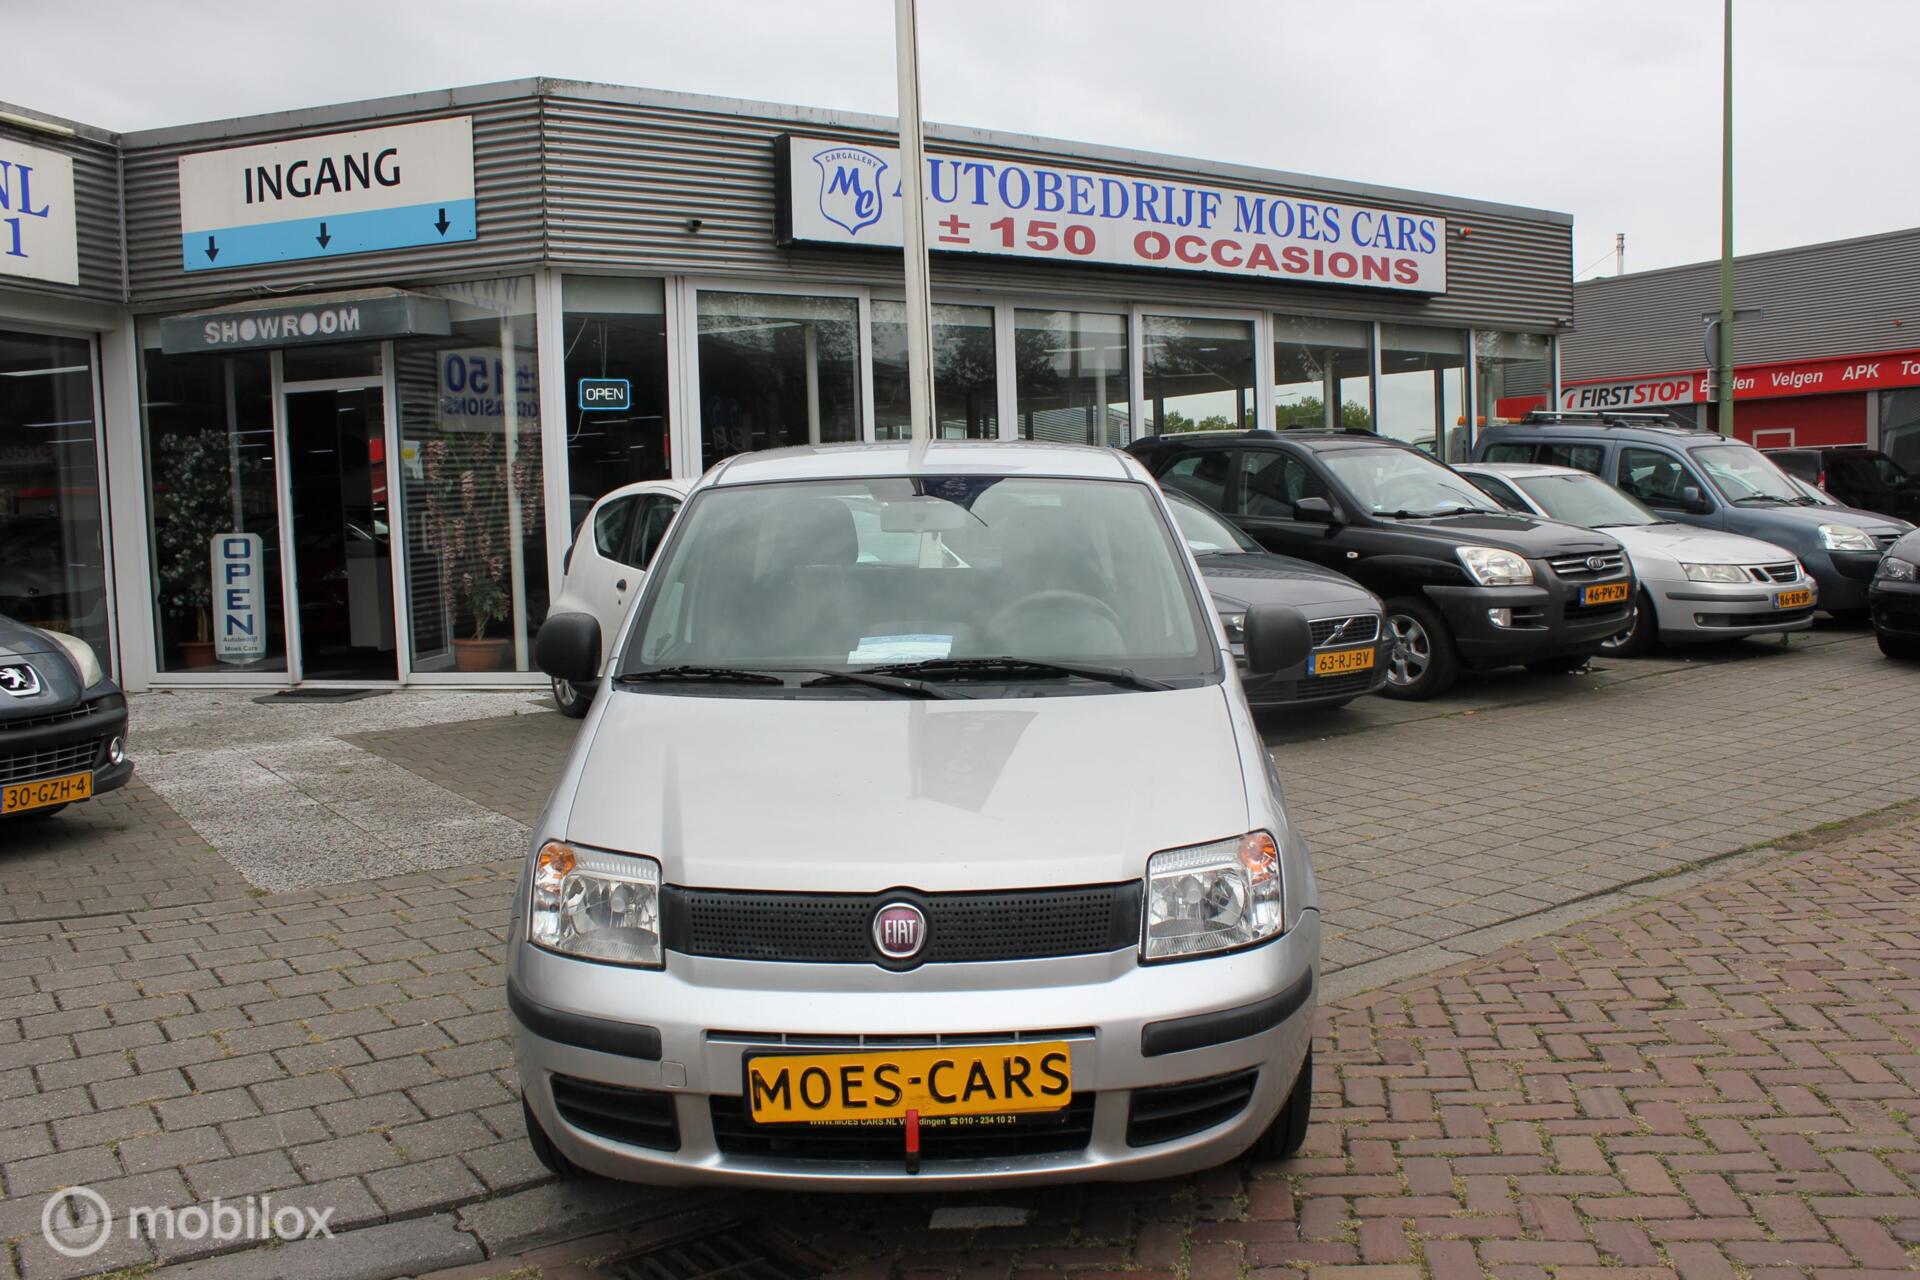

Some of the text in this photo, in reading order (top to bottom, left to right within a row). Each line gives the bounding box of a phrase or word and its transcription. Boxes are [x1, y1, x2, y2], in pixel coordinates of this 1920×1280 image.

[825, 152, 878, 168] CARGALLERY
[245, 148, 400, 204] INGANG
[892, 158, 1436, 255] UTOBEDRIJF MOES CARS
[990, 216, 1096, 255] 150
[1133, 231, 1419, 285] OCCASIONS
[204, 308, 360, 344] SHOWROOM
[1771, 372, 1823, 388] Velgen
[1842, 363, 1880, 381] APK
[586, 387, 624, 401] OPEN
[223, 538, 253, 635] OPEN
[223, 635, 258, 643] Autobedrijf
[1320, 651, 1370, 671] 63-RJ-BV
[7, 777, 86, 809] 30-GZH-4
[885, 919, 916, 944] FIAT
[752, 1053, 1069, 1111] MOES-CARS
[980, 1116, 994, 1125] 234
[996, 1115, 1006, 1124] 10
[1007, 1114, 1017, 1124] 21
